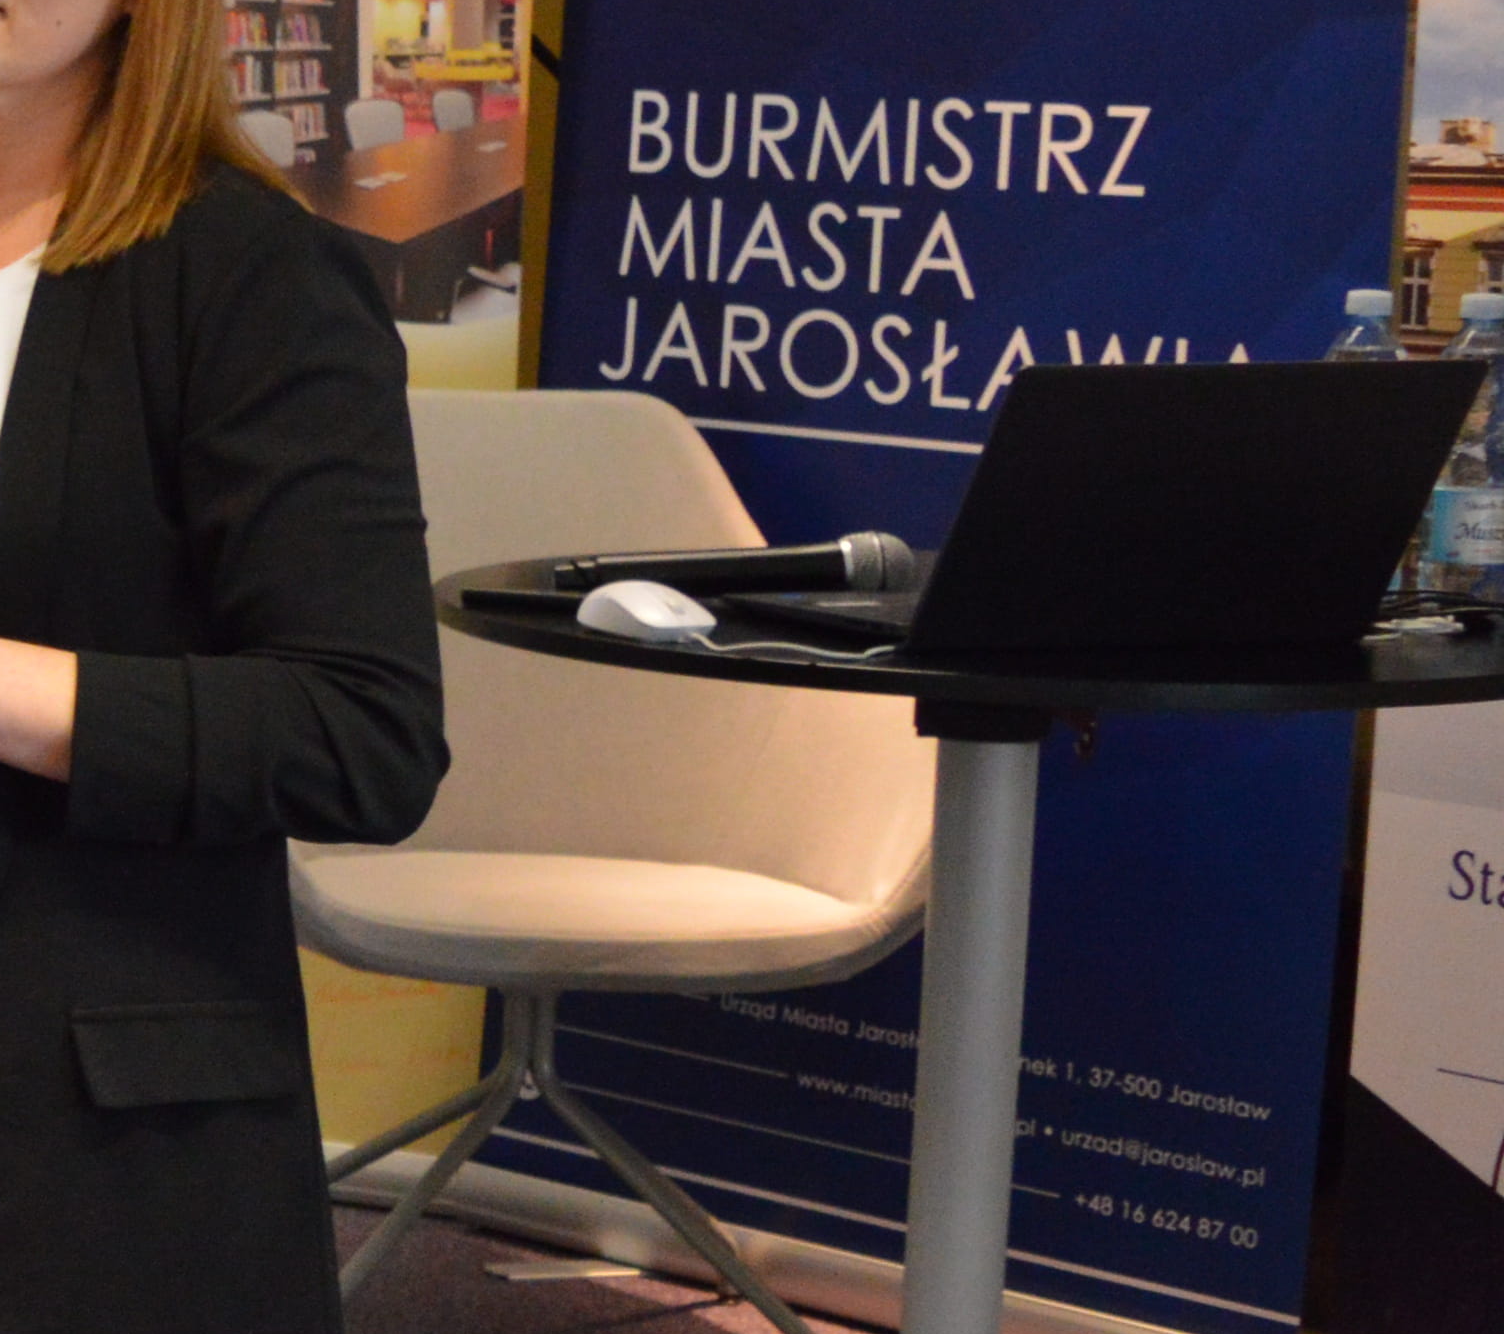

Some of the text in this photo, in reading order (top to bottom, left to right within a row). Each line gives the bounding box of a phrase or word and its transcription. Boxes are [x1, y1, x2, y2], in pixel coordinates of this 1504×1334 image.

[628, 89, 1152, 199] BURMISTRZ
[618, 196, 975, 301] MIASTA
[599, 297, 1253, 412] JAROSŁA
[782, 1008, 849, 1036] Miasta
[855, 1020, 922, 1049] Jarosł
[1088, 1067, 1162, 1099] 37-500
[1167, 1084, 1272, 1121] Jarosław
[1061, 1127, 1265, 1187] urzad@jaroslaw.pl
[1075, 1193, 1258, 1249] +48 16 624 87 00
